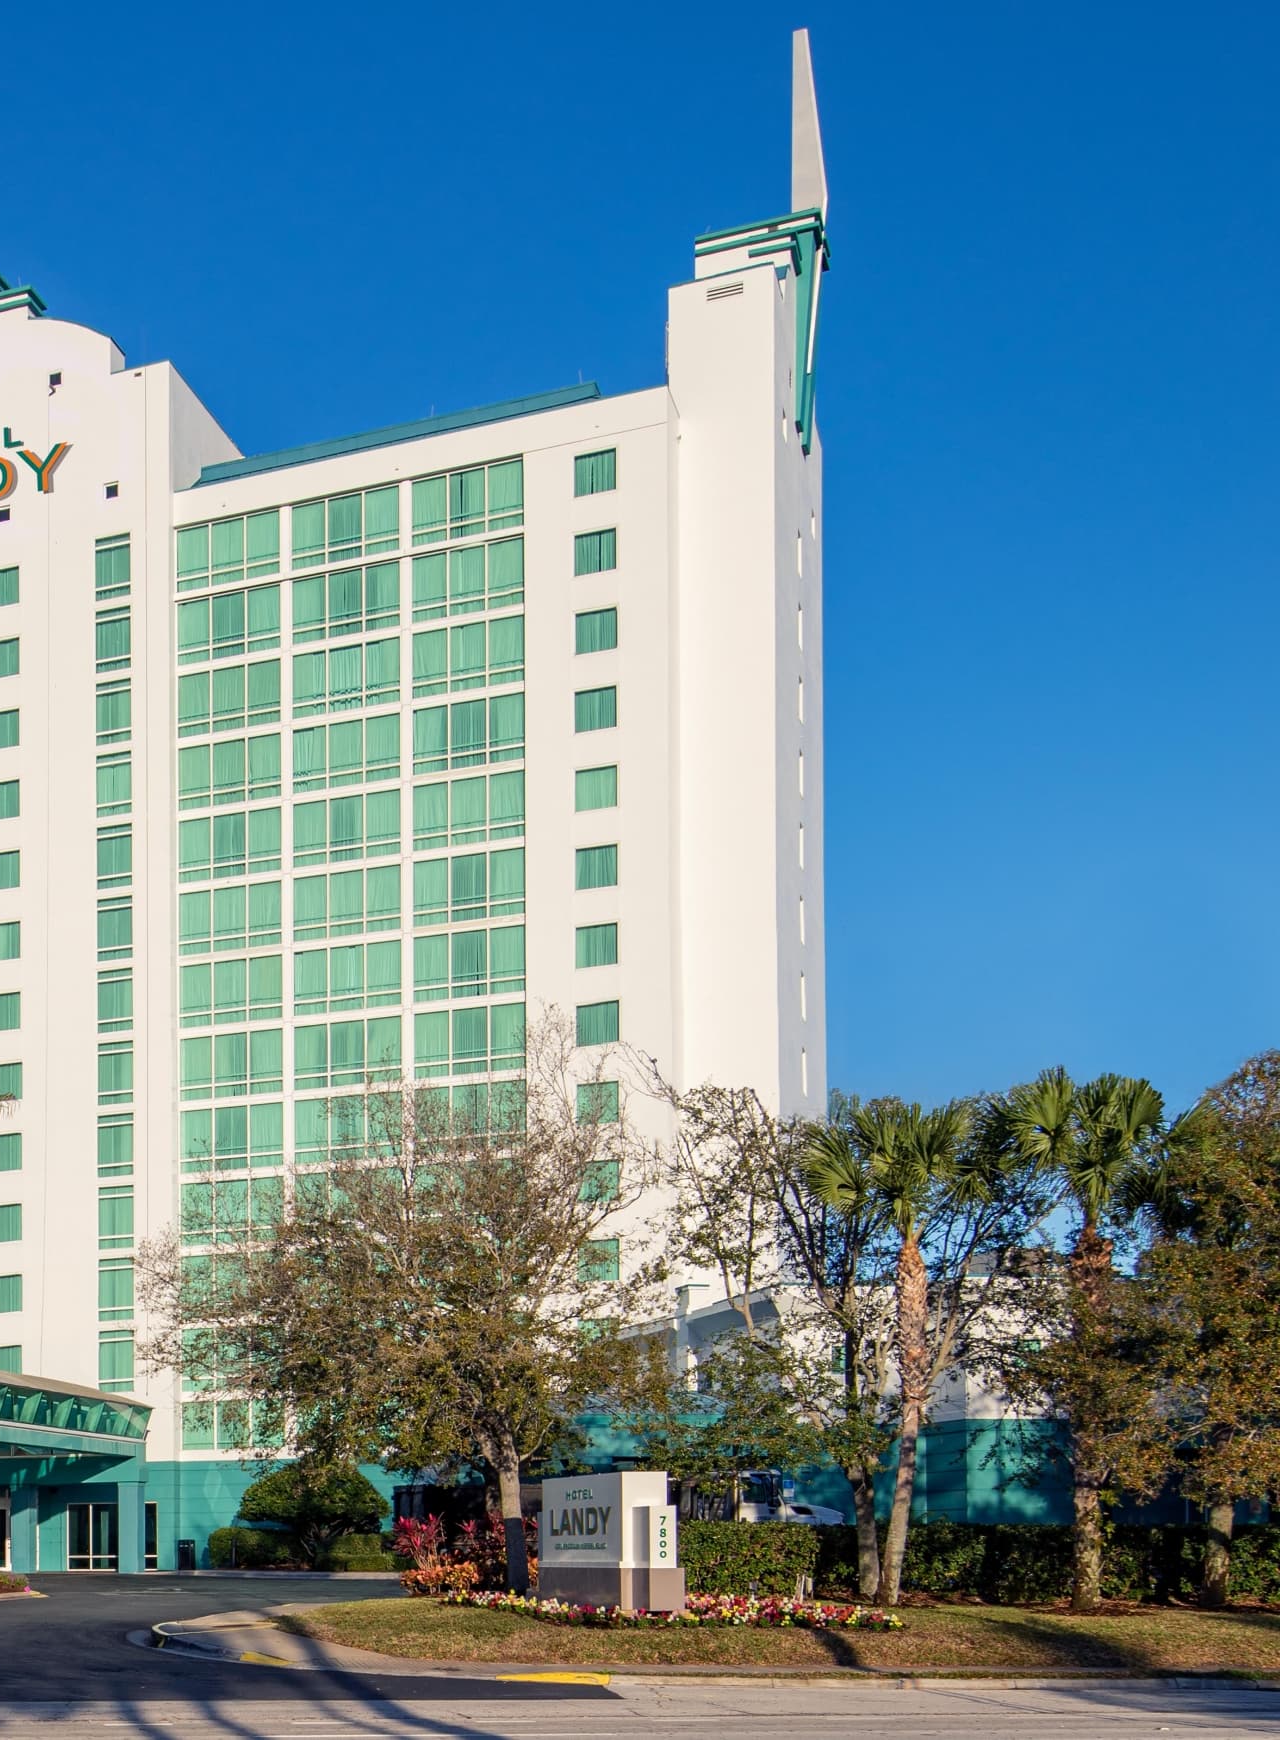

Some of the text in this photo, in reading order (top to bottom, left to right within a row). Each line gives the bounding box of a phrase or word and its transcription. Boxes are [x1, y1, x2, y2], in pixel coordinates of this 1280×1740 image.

[565, 1488, 593, 1500] HOTEL
[549, 1506, 612, 1537] LANDY
[659, 1515, 667, 1558] 7800
